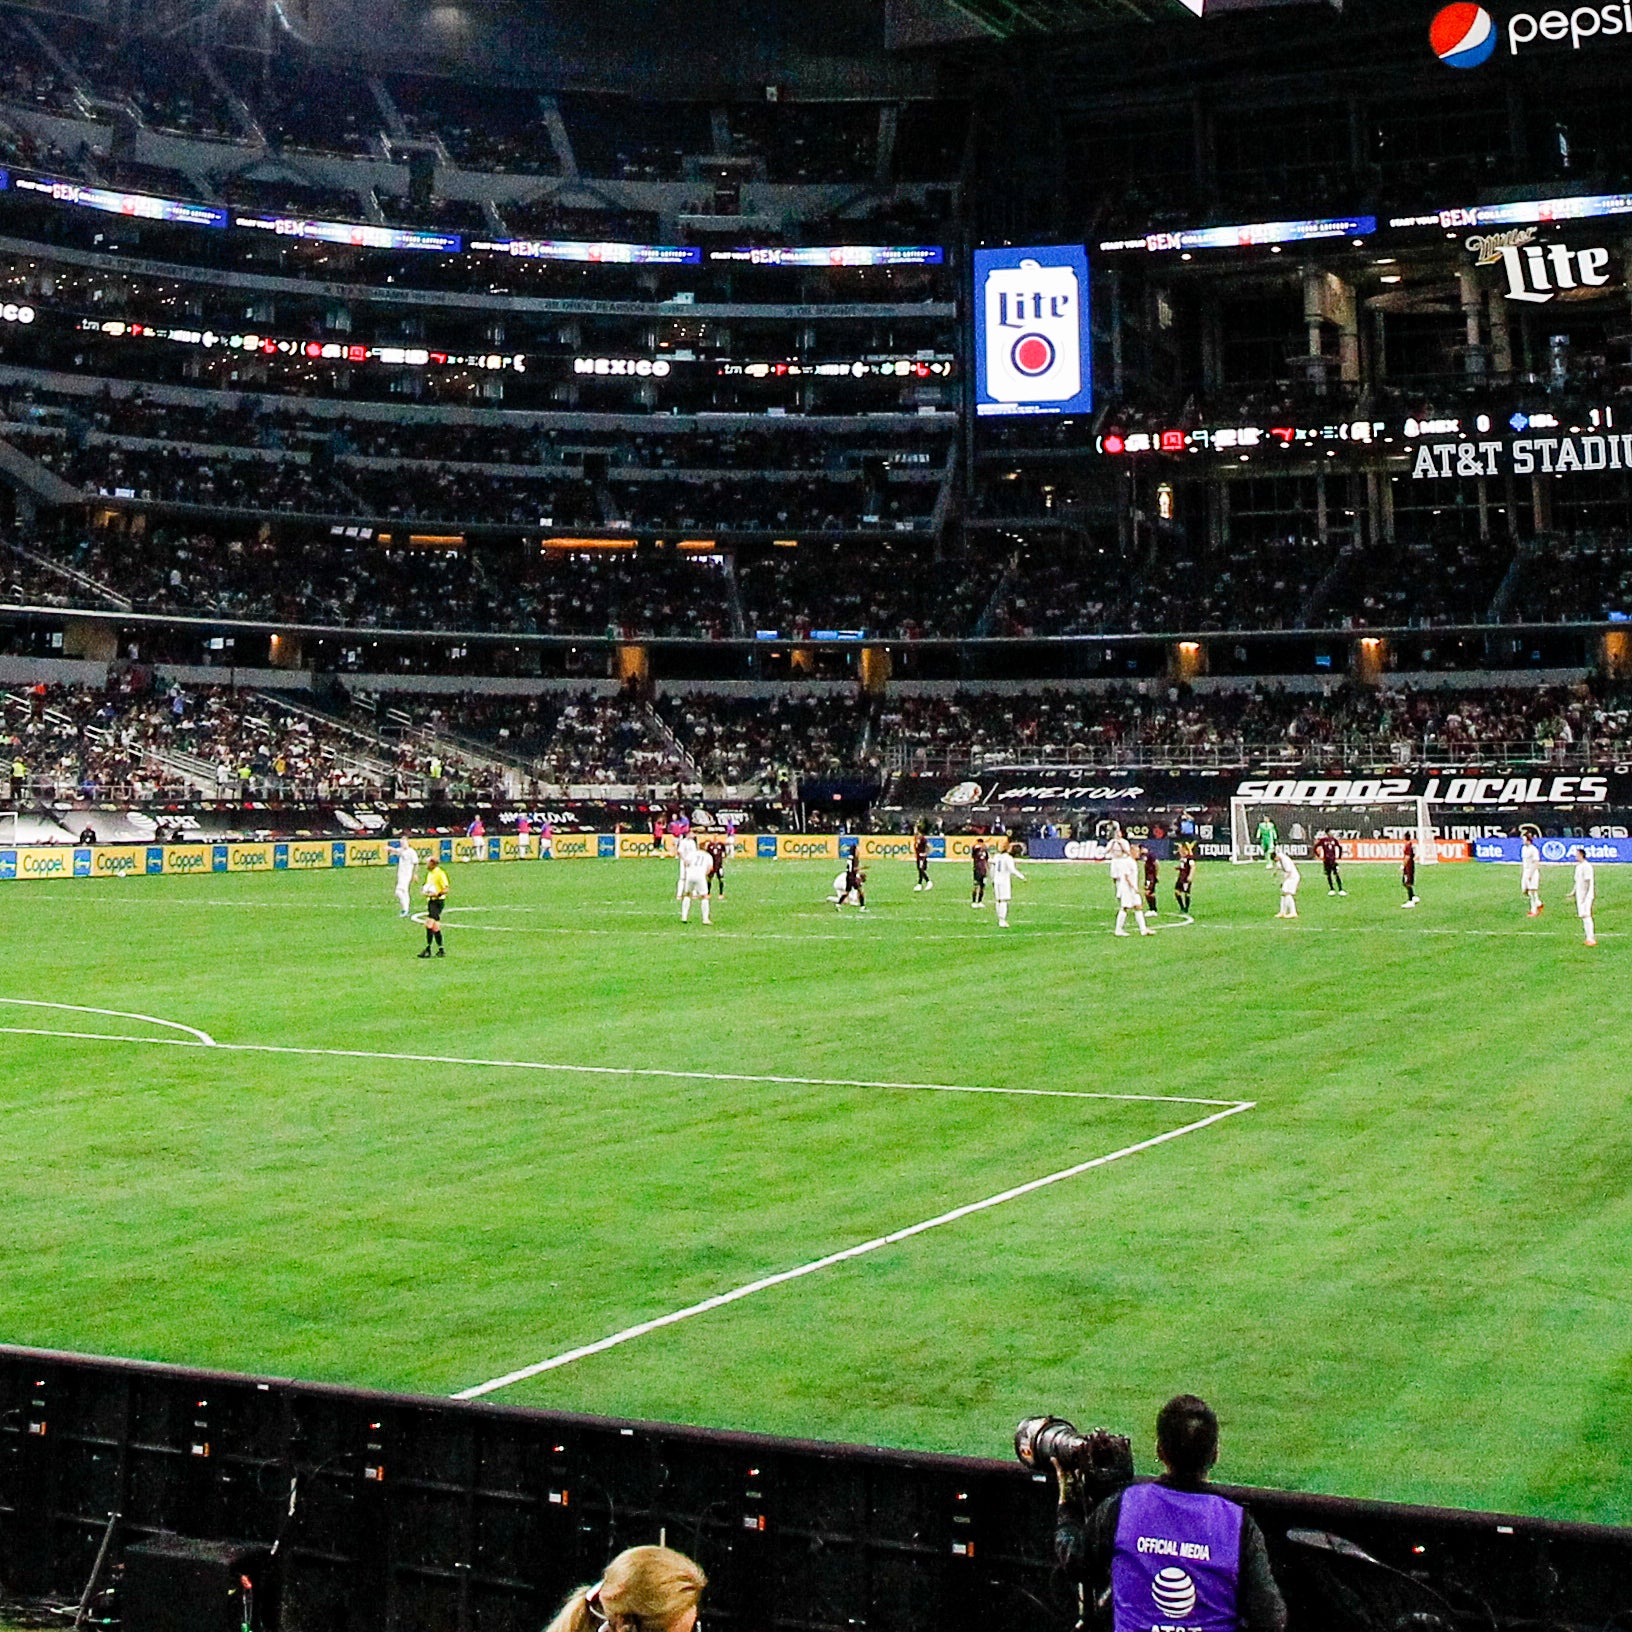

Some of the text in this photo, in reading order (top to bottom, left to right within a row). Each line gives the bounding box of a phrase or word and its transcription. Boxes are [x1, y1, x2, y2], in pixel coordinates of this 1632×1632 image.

[52, 183, 79, 203] GEM
[275, 219, 304, 238] GEM
[1439, 209, 1477, 228] GEM
[509, 241, 540, 258] GEM
[1146, 232, 1182, 252] GEM
[1465, 226, 1538, 266] Miller
[750, 249, 781, 264] GEM
[1496, 243, 1610, 303] Lite
[998, 290, 1069, 329] Lite
[573, 357, 671, 377] MEXICO
[1412, 441, 1503, 479] AT&T
[998, 785, 1145, 801] #MEXTOUR
[1424, 777, 1609, 804] LOCALES
[292, 848, 325, 864] Coppel
[350, 846, 382, 862] Coppel
[556, 843, 587, 858] Coppel
[783, 839, 829, 856] Coppel
[866, 839, 914, 856] Coppel
[23, 854, 67, 874] Coppel
[96, 853, 137, 873] Coppel
[167, 851, 206, 870] Coppel
[231, 849, 268, 869] Coppel
[1137, 1536, 1210, 1561] OFFICIAL MEDIA
